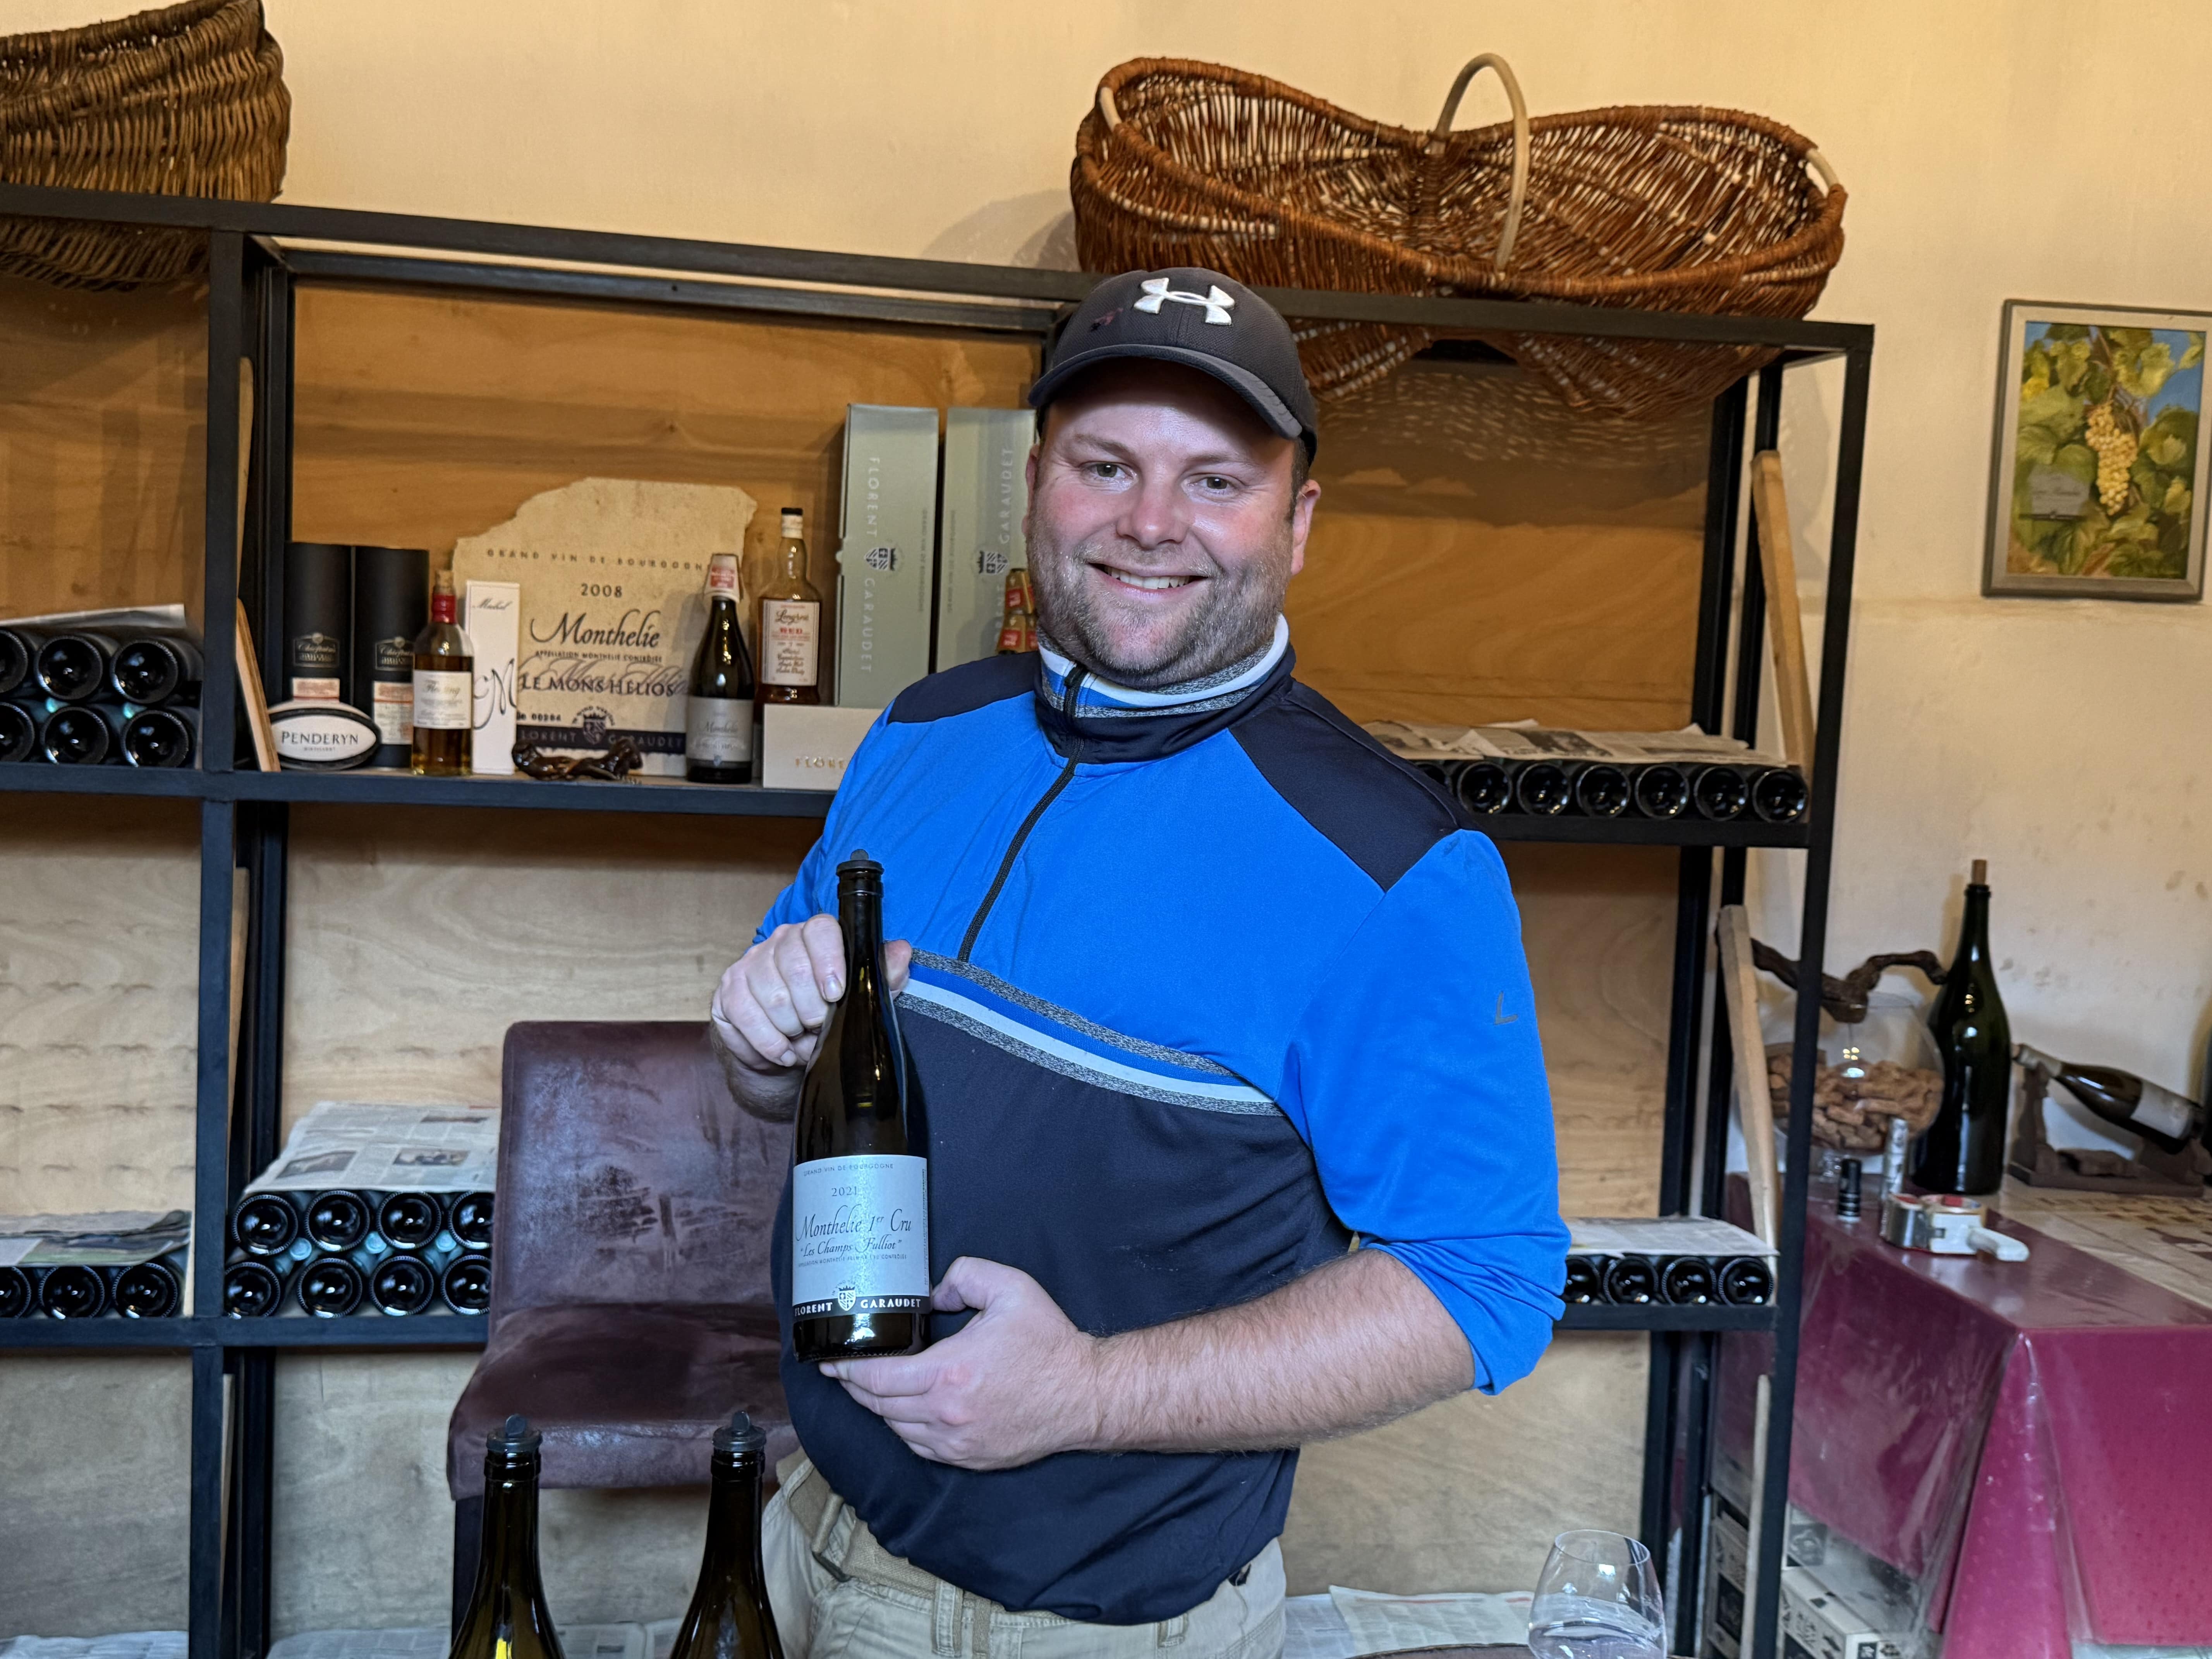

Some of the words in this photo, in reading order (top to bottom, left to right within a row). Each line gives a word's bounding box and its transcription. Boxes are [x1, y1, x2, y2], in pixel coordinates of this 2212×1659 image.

[866, 457, 880, 538] FLORENT
[998, 449, 1013, 544] GARAUDET
[487, 549, 539, 559] GRAND
[551, 553, 577, 562] VIN
[618, 558, 709, 571] BOURGOGN
[581, 583, 622, 598] 2008
[530, 609, 661, 648] Monthelie
[861, 578, 876, 673] GARAUDET
[522, 672, 541, 690] LE
[548, 677, 604, 693] MONS
[282, 731, 358, 745] PENDERYN
[521, 730, 577, 742] LORENT
[608, 735, 684, 748] GAUDET
[831, 1186, 857, 1197] 2021
[796, 1204, 862, 1241] Monthelie
[891, 1208, 911, 1231] Cru
[817, 1237, 852, 1259] Champs
[794, 1302, 833, 1317] FLORENT
[860, 1298, 921, 1309] GARAUDET
